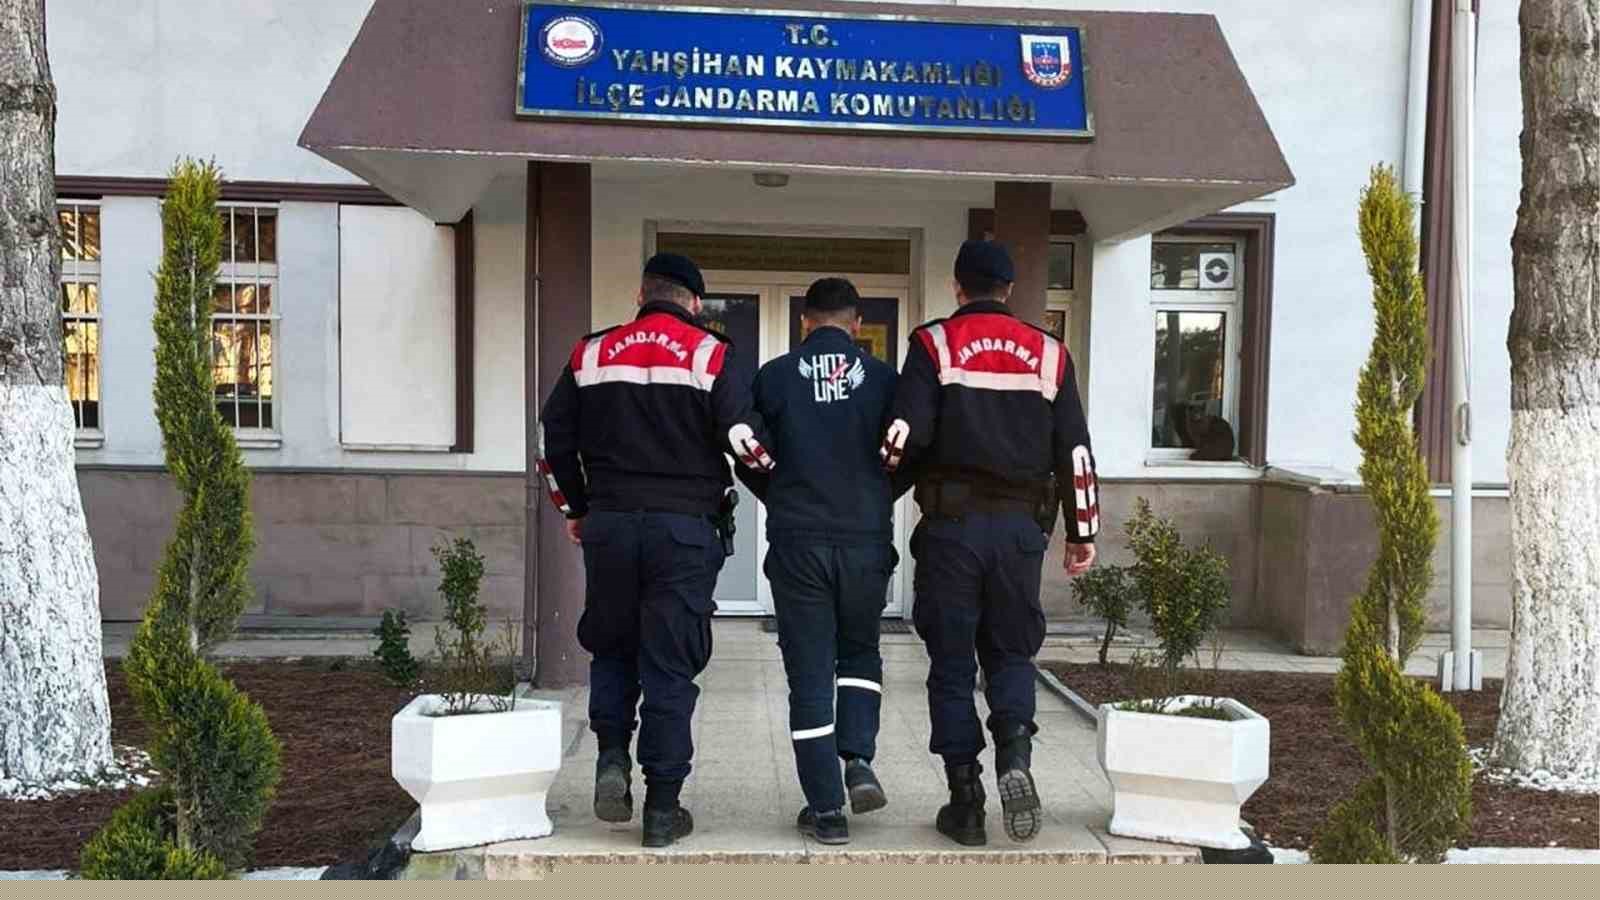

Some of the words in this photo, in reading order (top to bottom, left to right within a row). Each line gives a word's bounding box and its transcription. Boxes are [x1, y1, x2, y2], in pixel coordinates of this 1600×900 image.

[785, 24, 839, 47] T.C.
[612, 47, 764, 79] YAHŞİHAN
[775, 56, 1001, 87] KAYMAKAMLIĞI
[576, 76, 645, 111] İLÇE
[654, 85, 820, 113] JANDARMA
[831, 92, 1036, 121] KOMUTANLIĞI
[607, 331, 688, 362] JANDARMA
[958, 337, 1040, 369] JANDARMA
[811, 353, 849, 381] HOT
